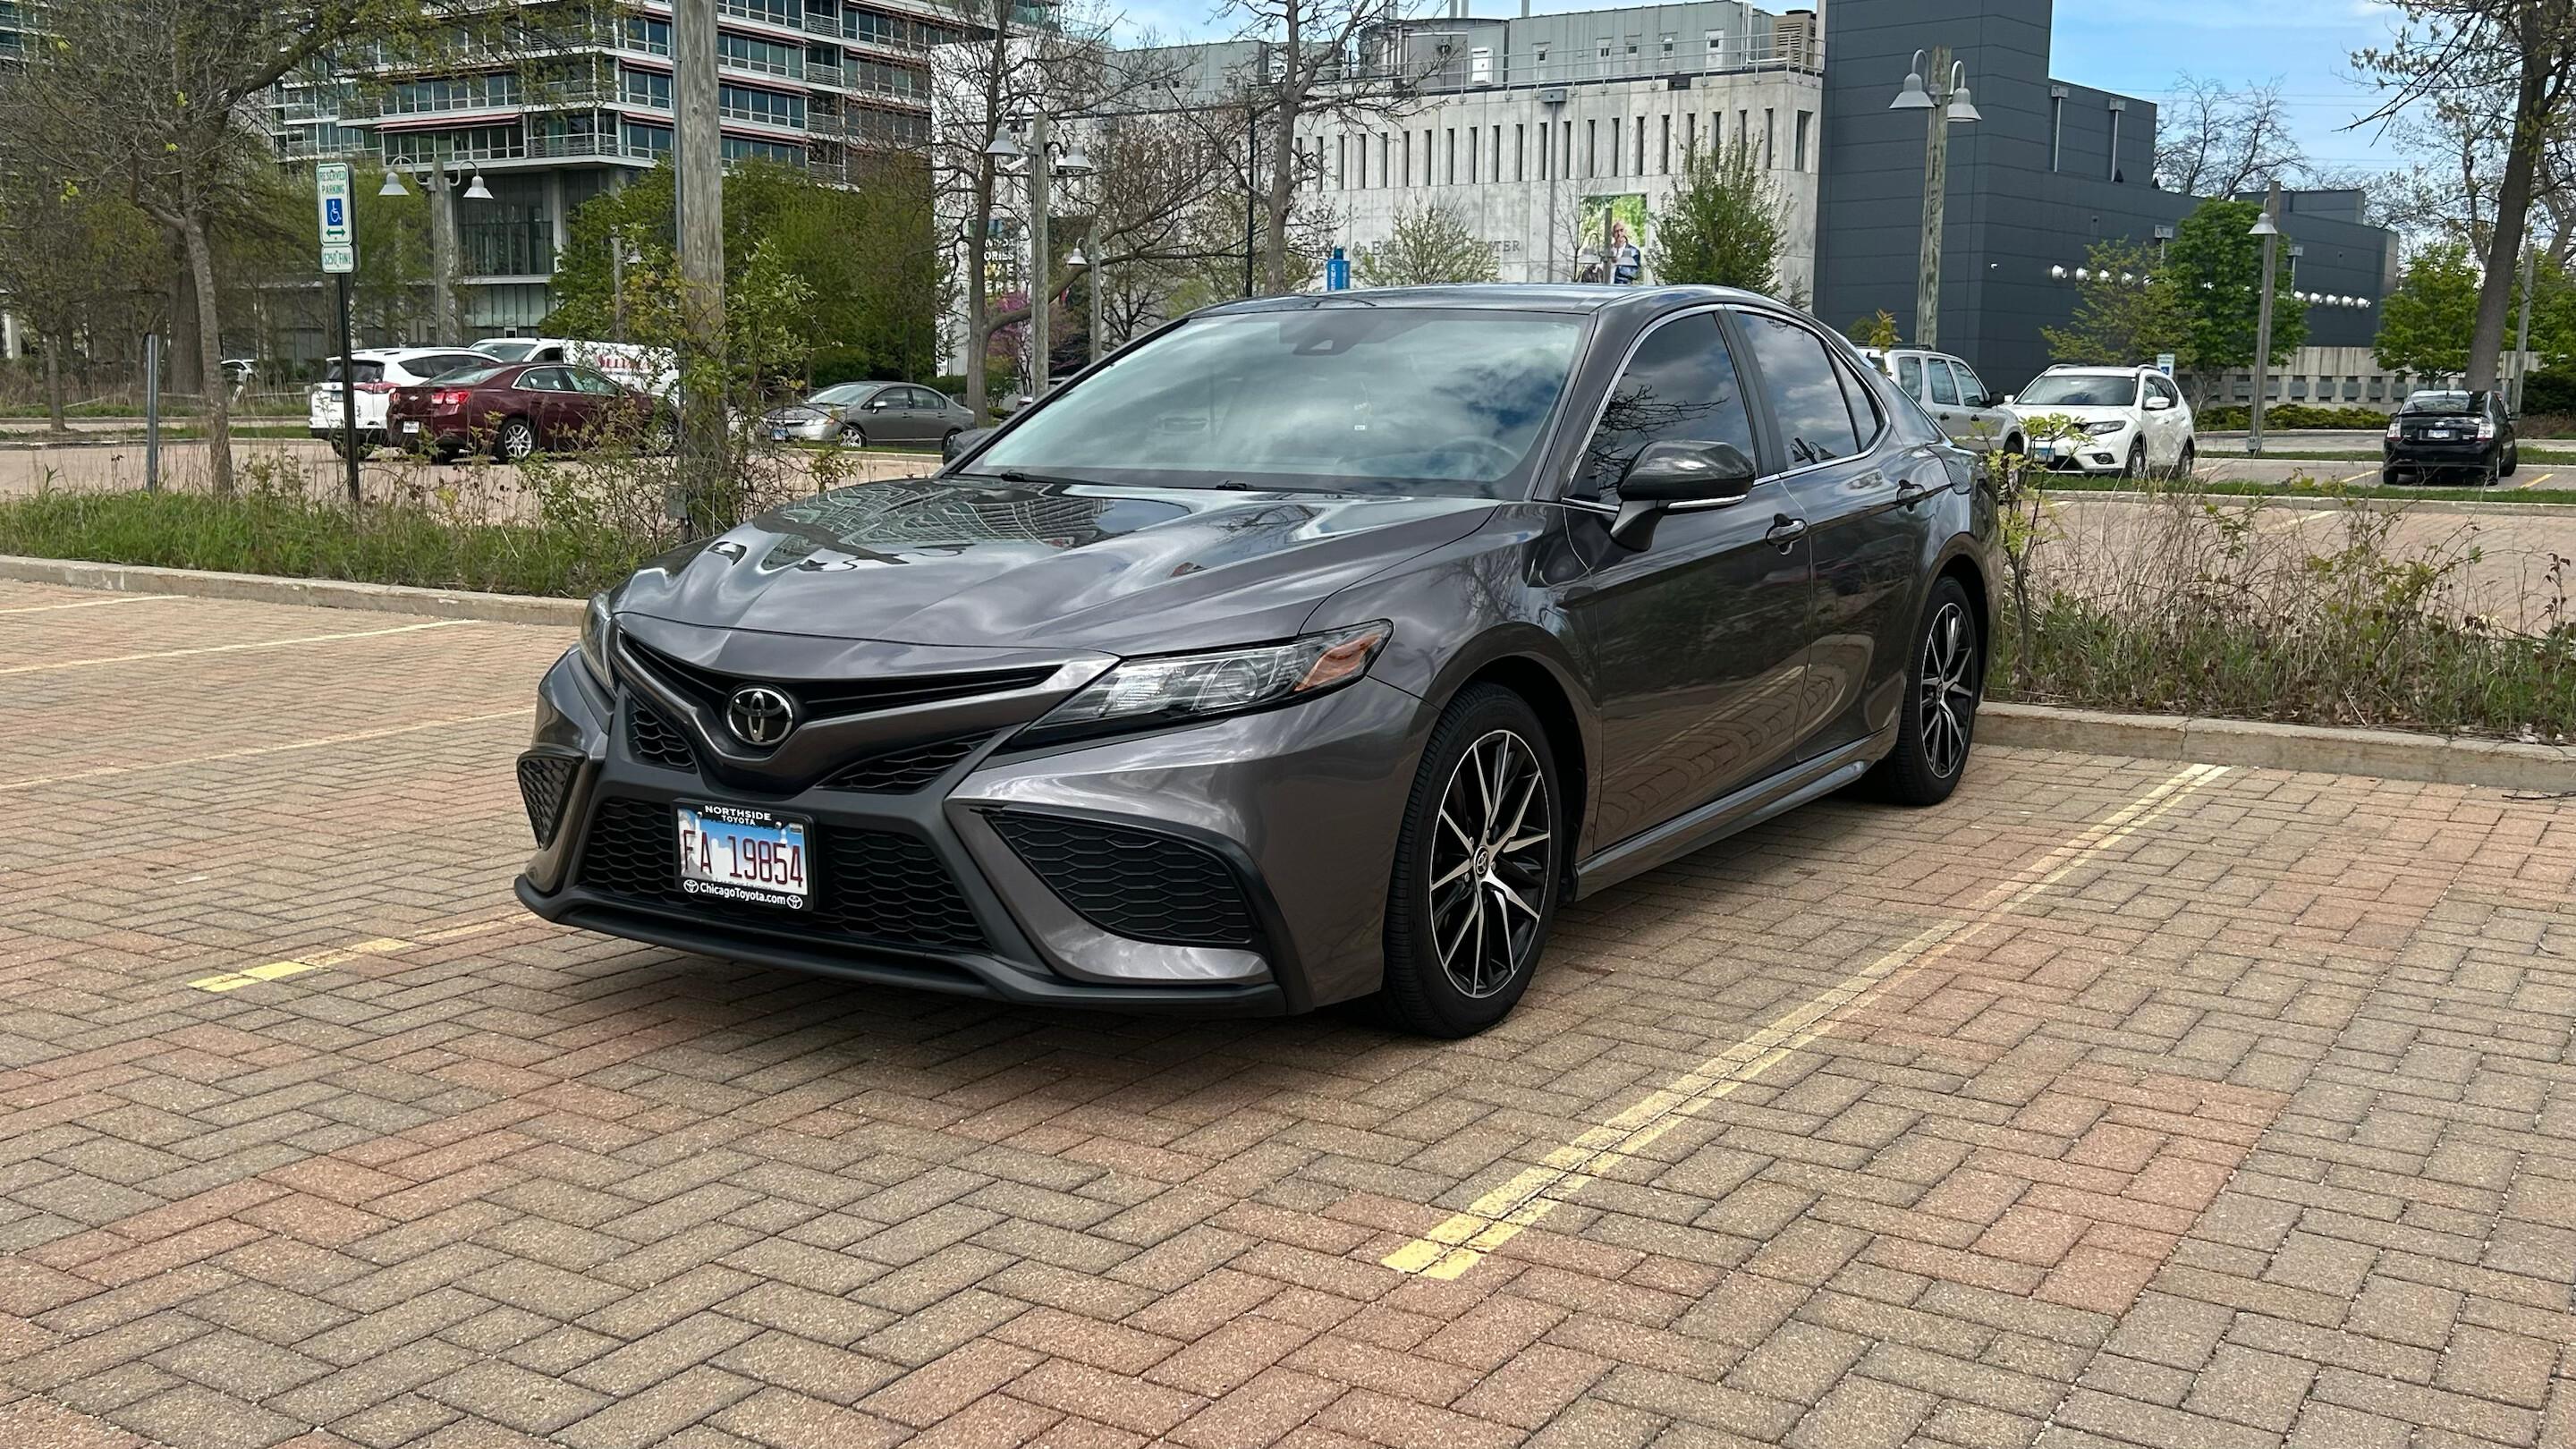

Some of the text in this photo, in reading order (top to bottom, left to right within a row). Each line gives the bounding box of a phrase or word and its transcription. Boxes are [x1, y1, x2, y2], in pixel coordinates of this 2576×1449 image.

[319, 171, 346, 182] RESERVED
[322, 184, 345, 195] PARKING
[324, 252, 352, 266] $250 FINE
[705, 805, 772, 821] NORTHSIDE
[721, 815, 756, 826] TOYOTA
[683, 829, 803, 888] FA 19854
[699, 882, 786, 905] ChicagoToyota.com
